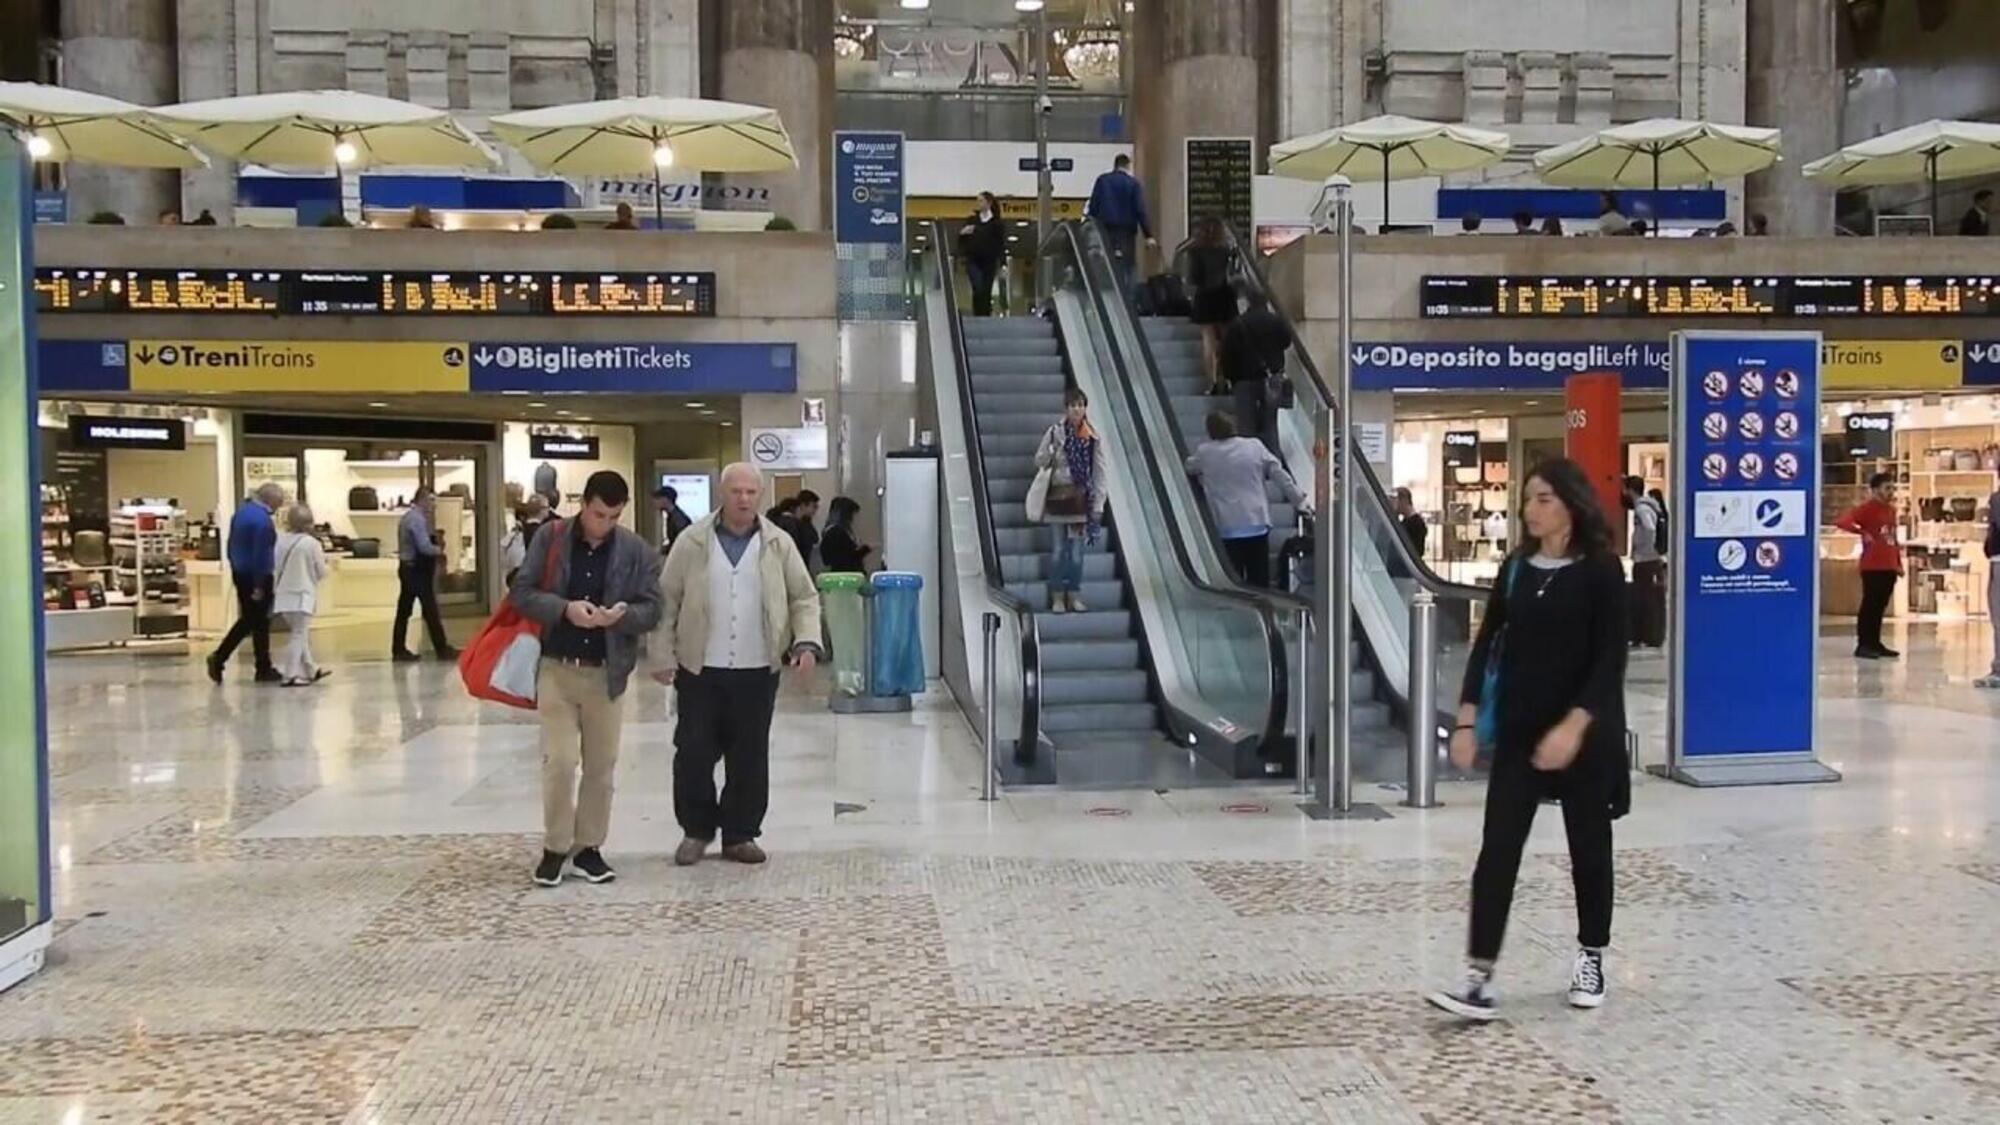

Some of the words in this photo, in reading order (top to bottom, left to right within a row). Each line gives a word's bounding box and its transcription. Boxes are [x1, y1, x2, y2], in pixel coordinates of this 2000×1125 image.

[601, 181, 769, 201] mignon
[1391, 345, 1501, 372] Deposito
[1644, 344, 1672, 371] lug
